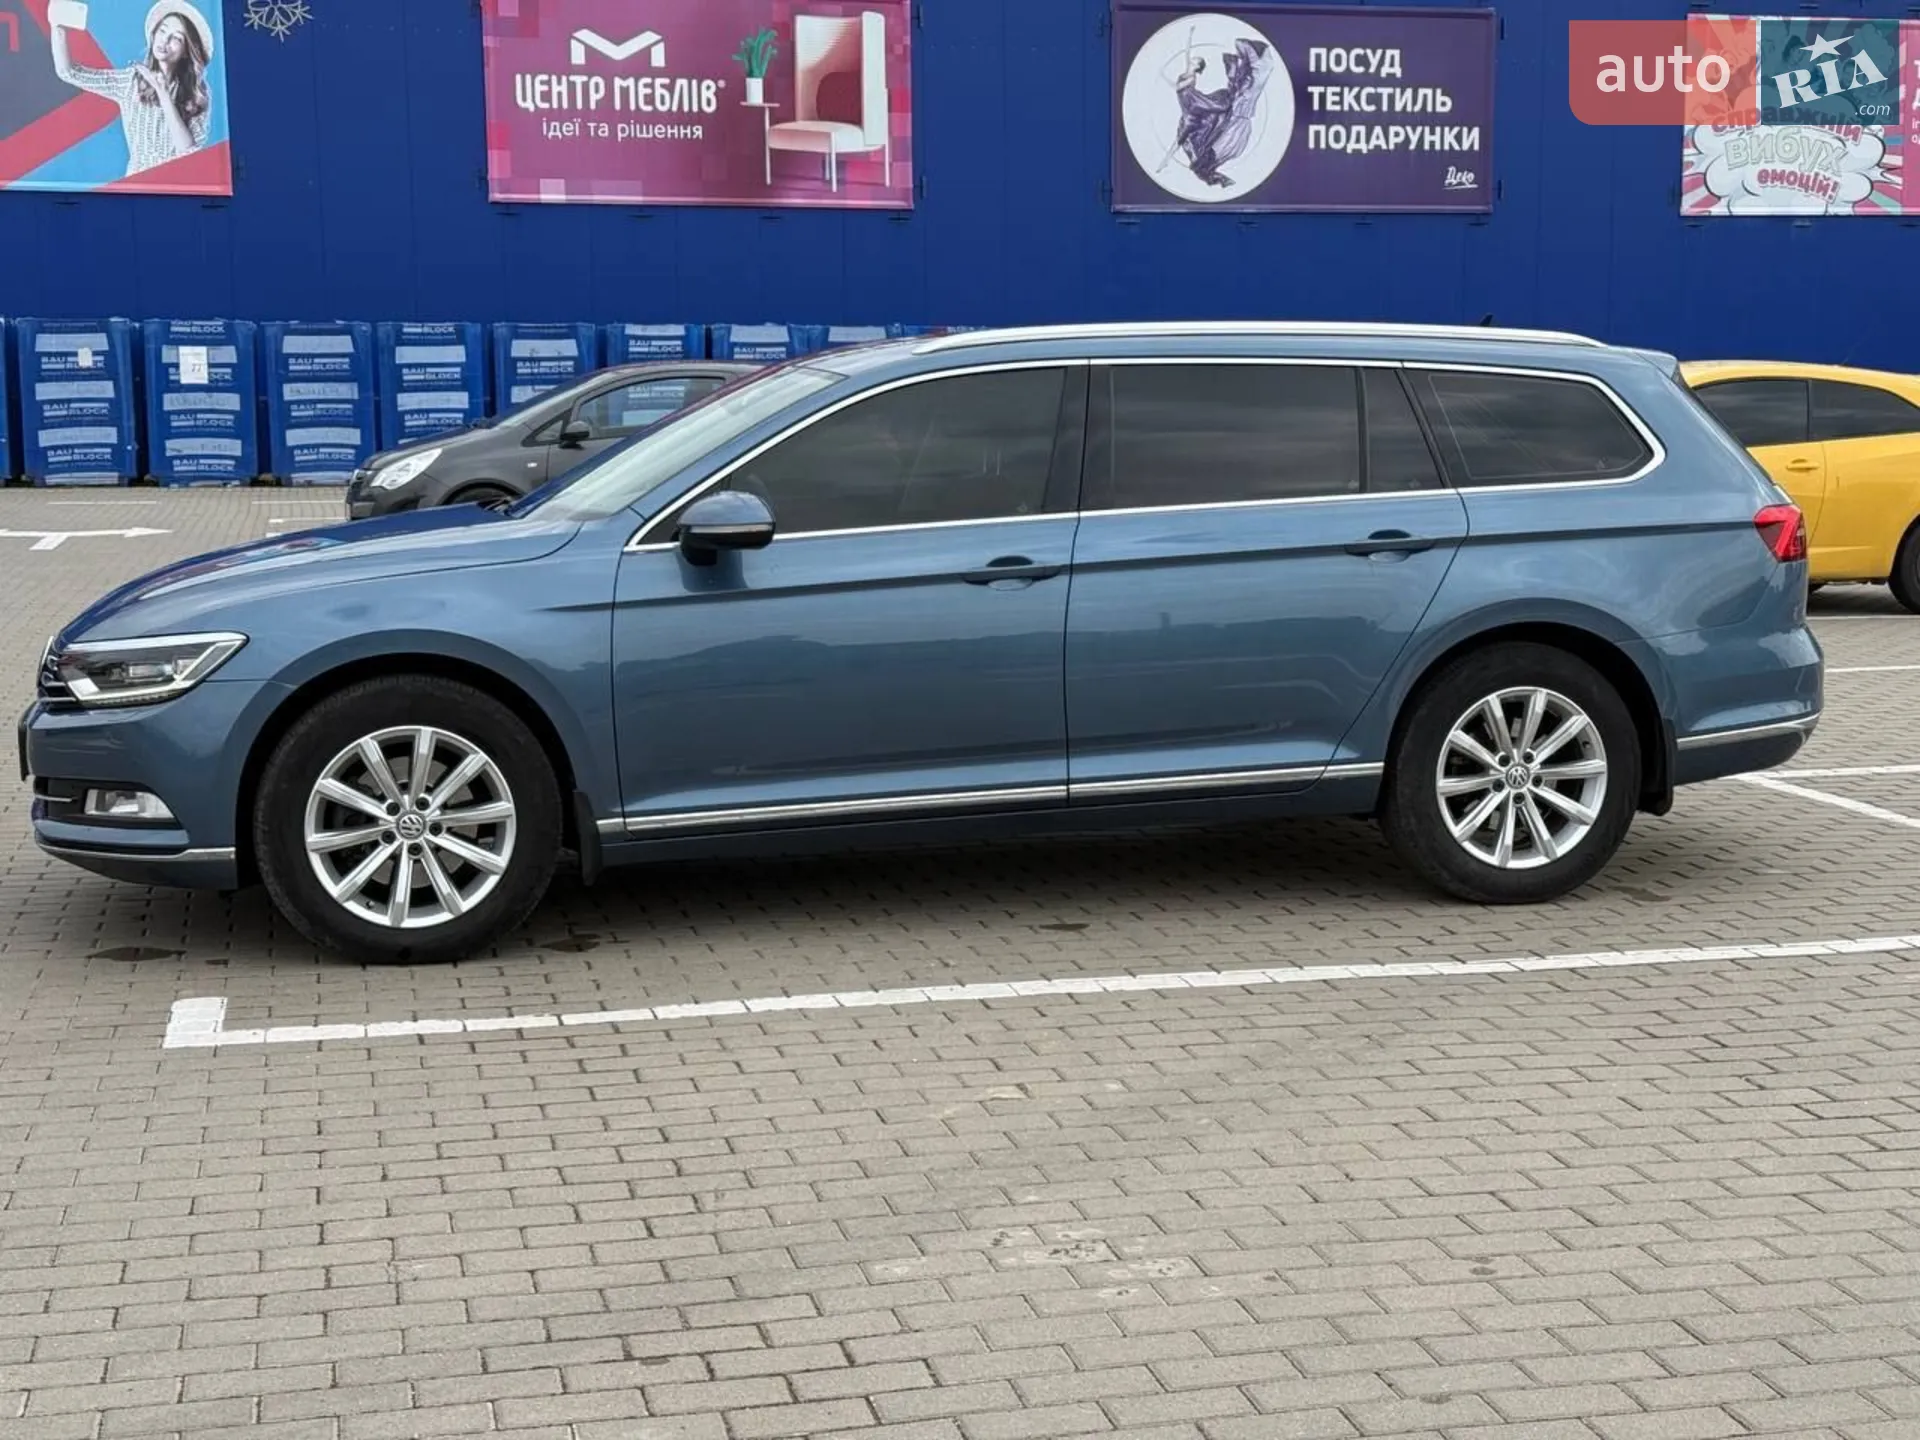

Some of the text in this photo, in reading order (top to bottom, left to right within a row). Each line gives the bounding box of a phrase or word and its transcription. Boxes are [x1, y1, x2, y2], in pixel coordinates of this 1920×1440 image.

[1308, 47, 1402, 78] ПОСУД
[515, 73, 605, 112] ЦЕНТР
[1307, 86, 1453, 113] ТЕКСТИЛЬ
[542, 117, 703, 142] ідеї та рішення
[1308, 124, 1481, 154] ПОДАРУНКИ
